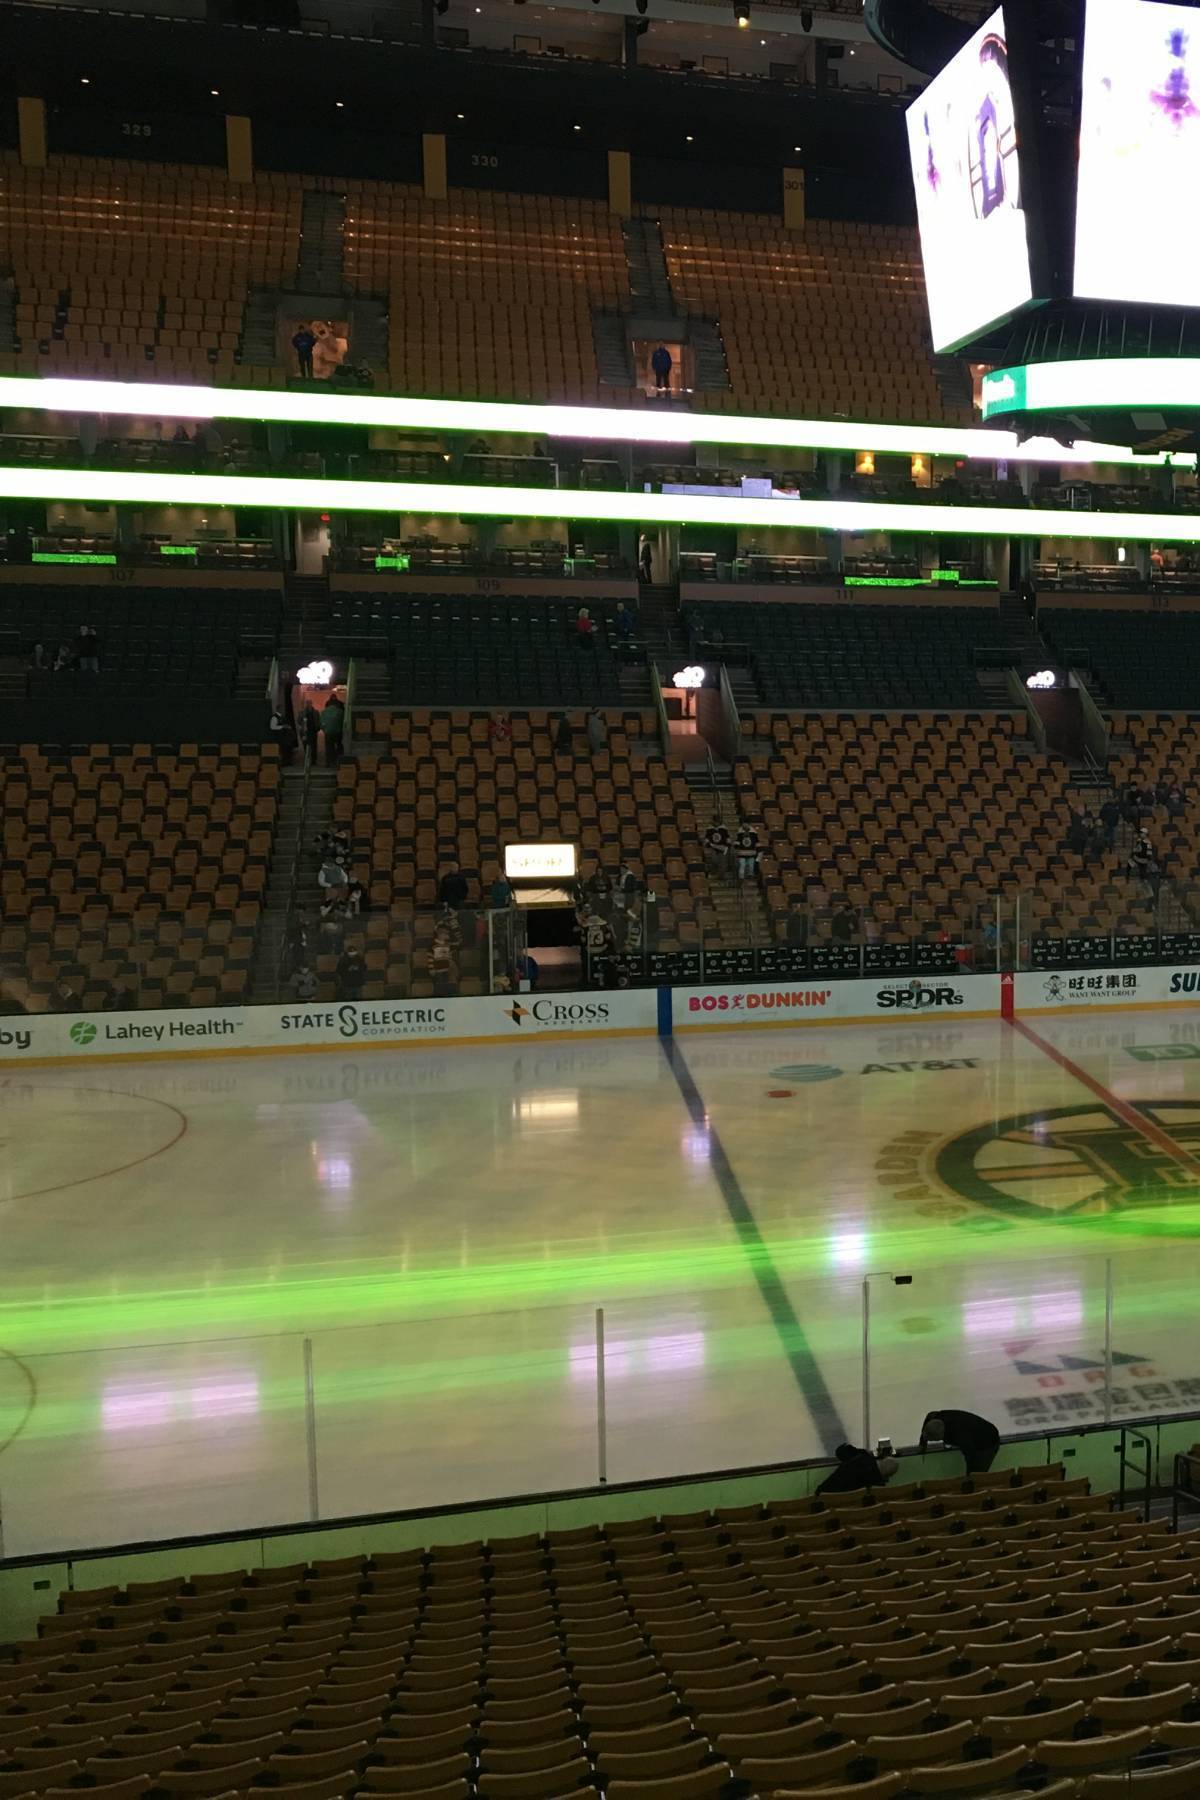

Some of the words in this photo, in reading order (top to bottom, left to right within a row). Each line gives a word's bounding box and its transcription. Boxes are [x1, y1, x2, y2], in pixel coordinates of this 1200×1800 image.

[471, 154, 499, 168] 330
[110, 569, 135, 582] 107
[476, 579, 501, 591] 109
[836, 588, 855, 600] 111
[1069, 973, 1137, 990] 旺旺集团
[688, 994, 729, 1012] BOS
[746, 990, 832, 1009] DUNKIN'
[281, 1013, 334, 1030] STATE
[361, 1008, 446, 1026] ELECTRIC
[105, 1022, 165, 1041] Lahey
[169, 1019, 235, 1037] Health
[361, 1025, 446, 1036] CORPORATION
[860, 1057, 982, 1076] AT&T
